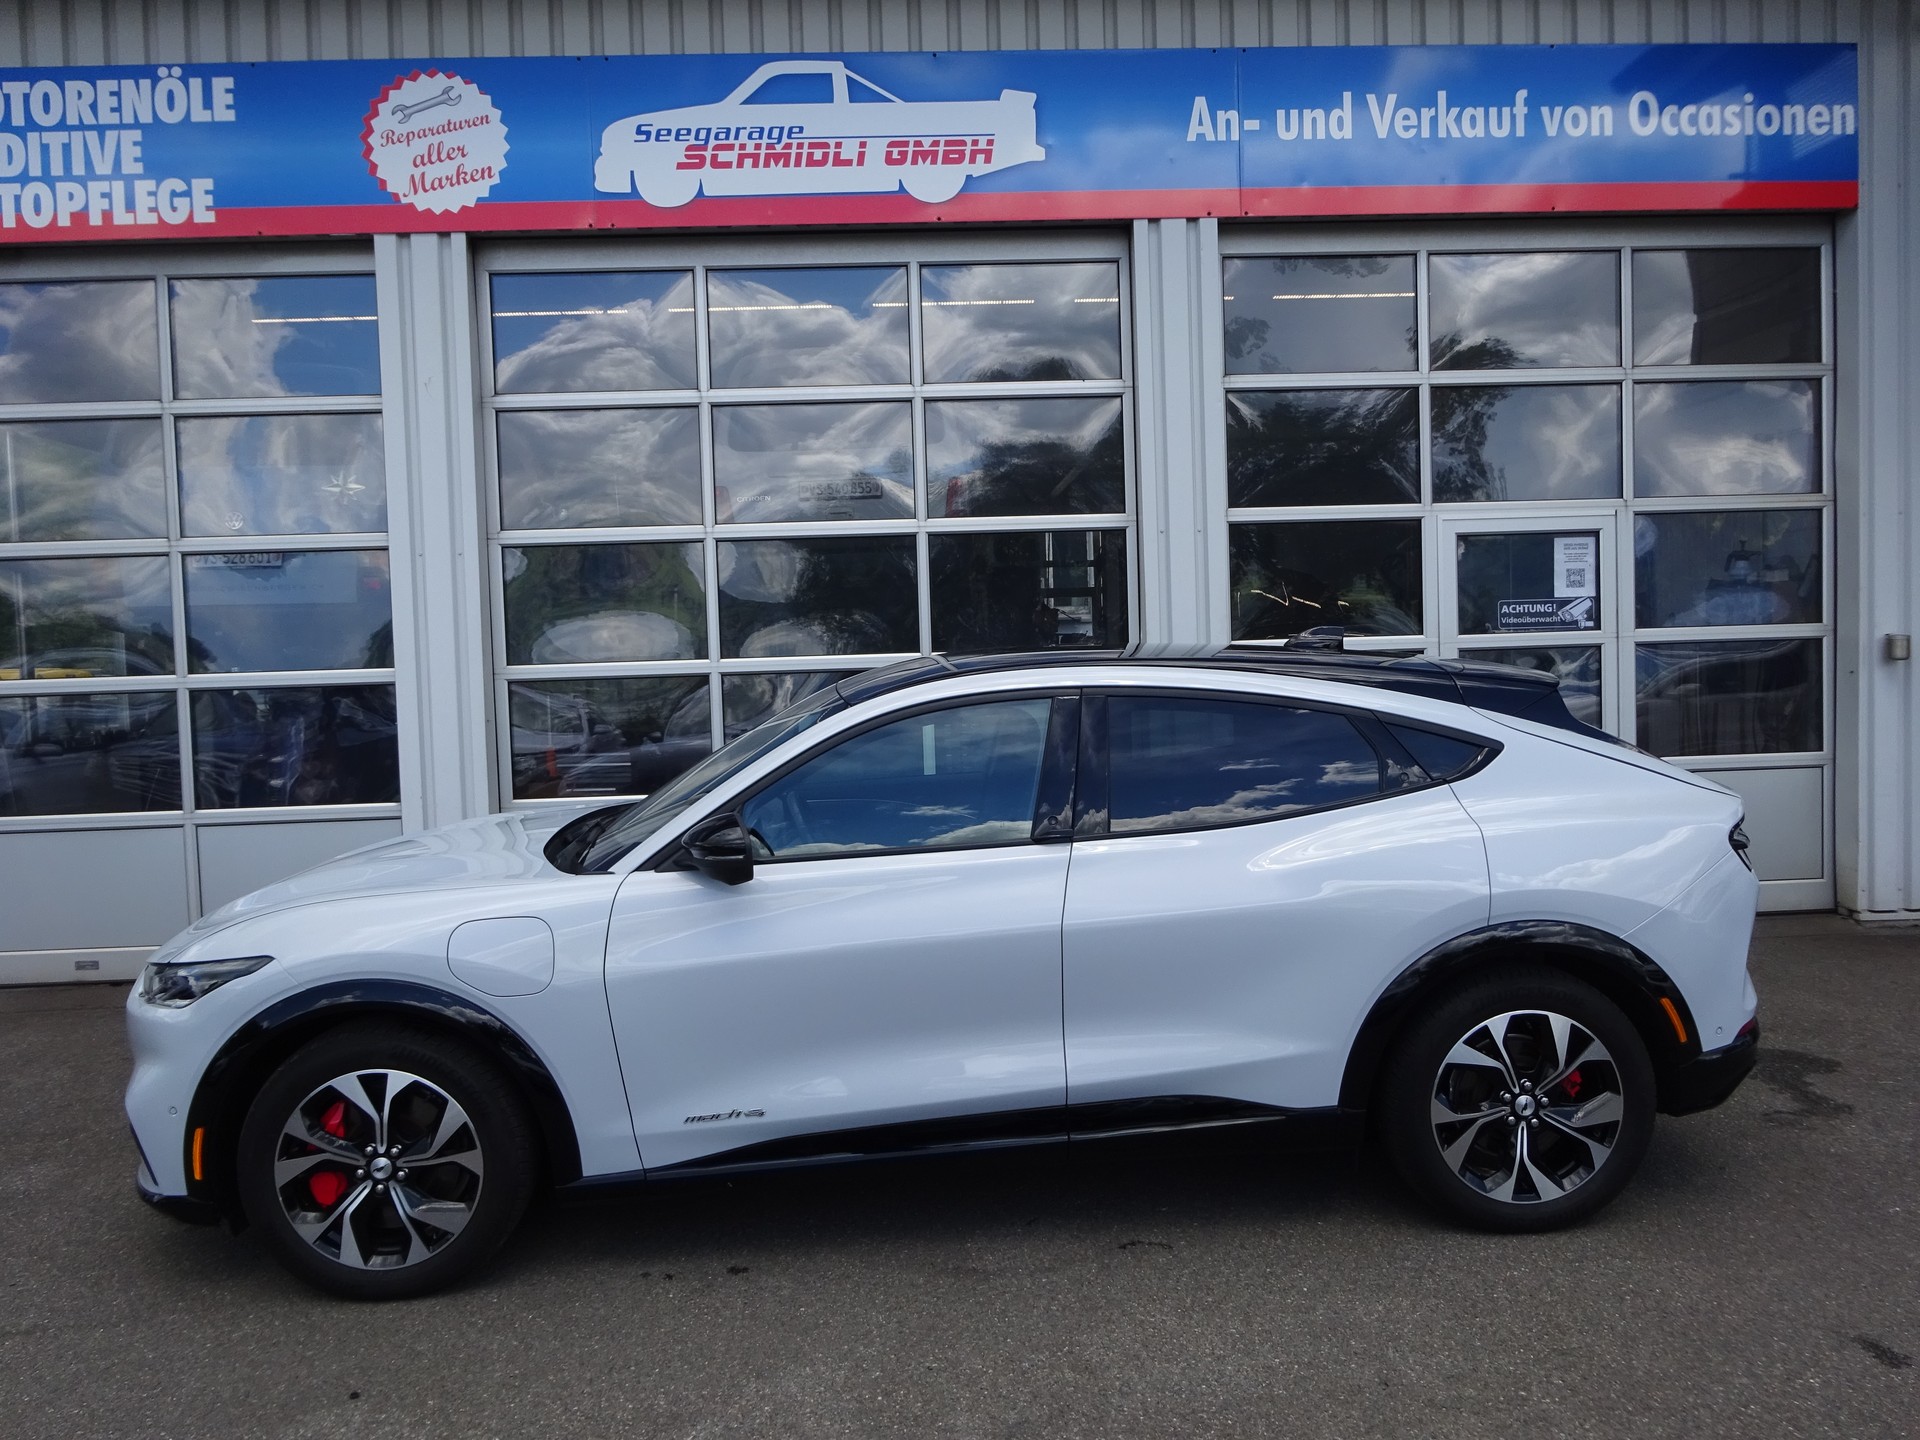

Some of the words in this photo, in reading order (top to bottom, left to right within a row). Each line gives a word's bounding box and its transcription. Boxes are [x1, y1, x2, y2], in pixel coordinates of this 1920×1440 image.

[0, 66, 236, 127] TORENÖLE
[380, 114, 491, 148] Reparaturen
[1187, 96, 1260, 142] An-
[1276, 91, 1352, 140] und
[1366, 89, 1528, 139] Verkauf
[1541, 105, 1613, 137] von
[1628, 91, 1855, 137] Occasionen
[634, 124, 804, 146] Seegarage
[412, 141, 468, 168] aller
[676, 141, 867, 170] SCHMIDLI
[884, 139, 995, 166] GMBH
[402, 163, 496, 198] Marken
[1501, 603, 1557, 614] ACHTUNG!
[1501, 615, 1562, 624] Videoüberwacht
